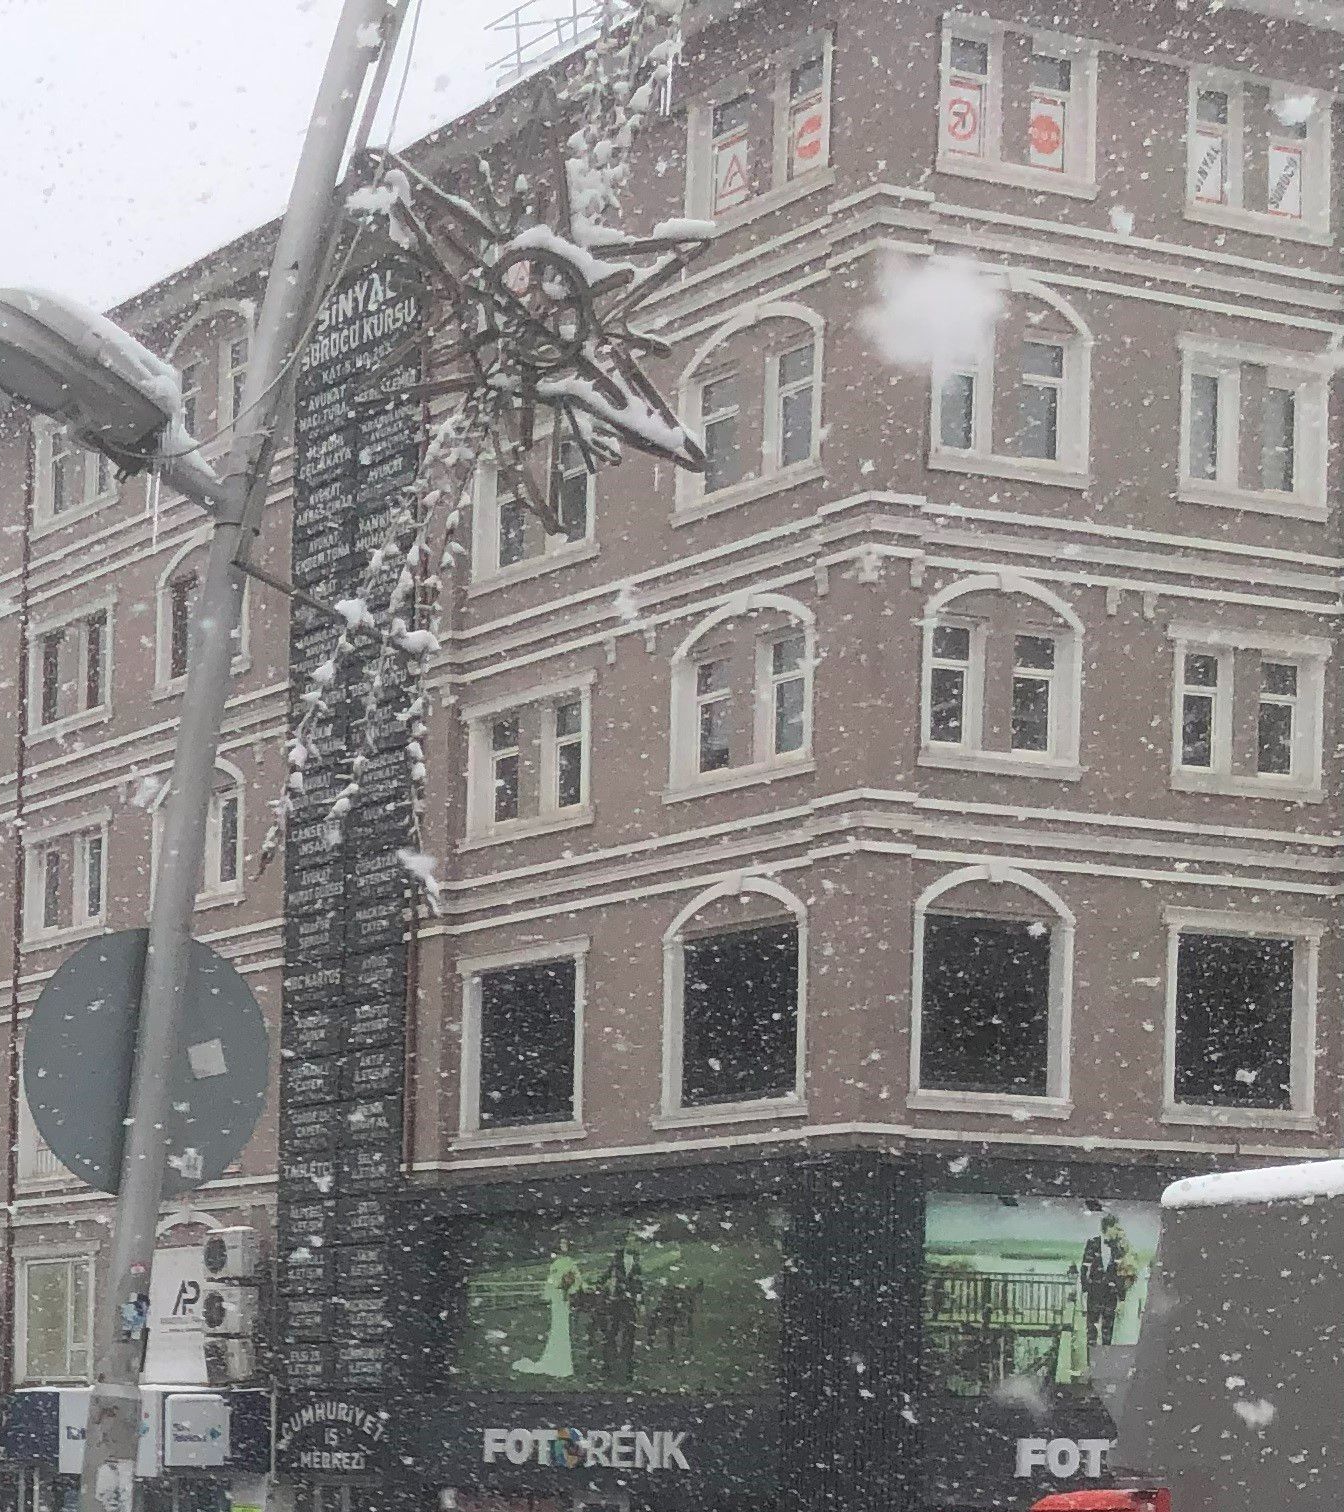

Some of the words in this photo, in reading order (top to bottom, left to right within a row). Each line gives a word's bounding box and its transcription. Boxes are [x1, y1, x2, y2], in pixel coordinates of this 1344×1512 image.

[316, 270, 397, 331] SİNYAL
[363, 296, 417, 343] KURSU
[280, 1401, 384, 1441] CUMHURİYET
[1014, 1437, 1111, 1478] FOT
